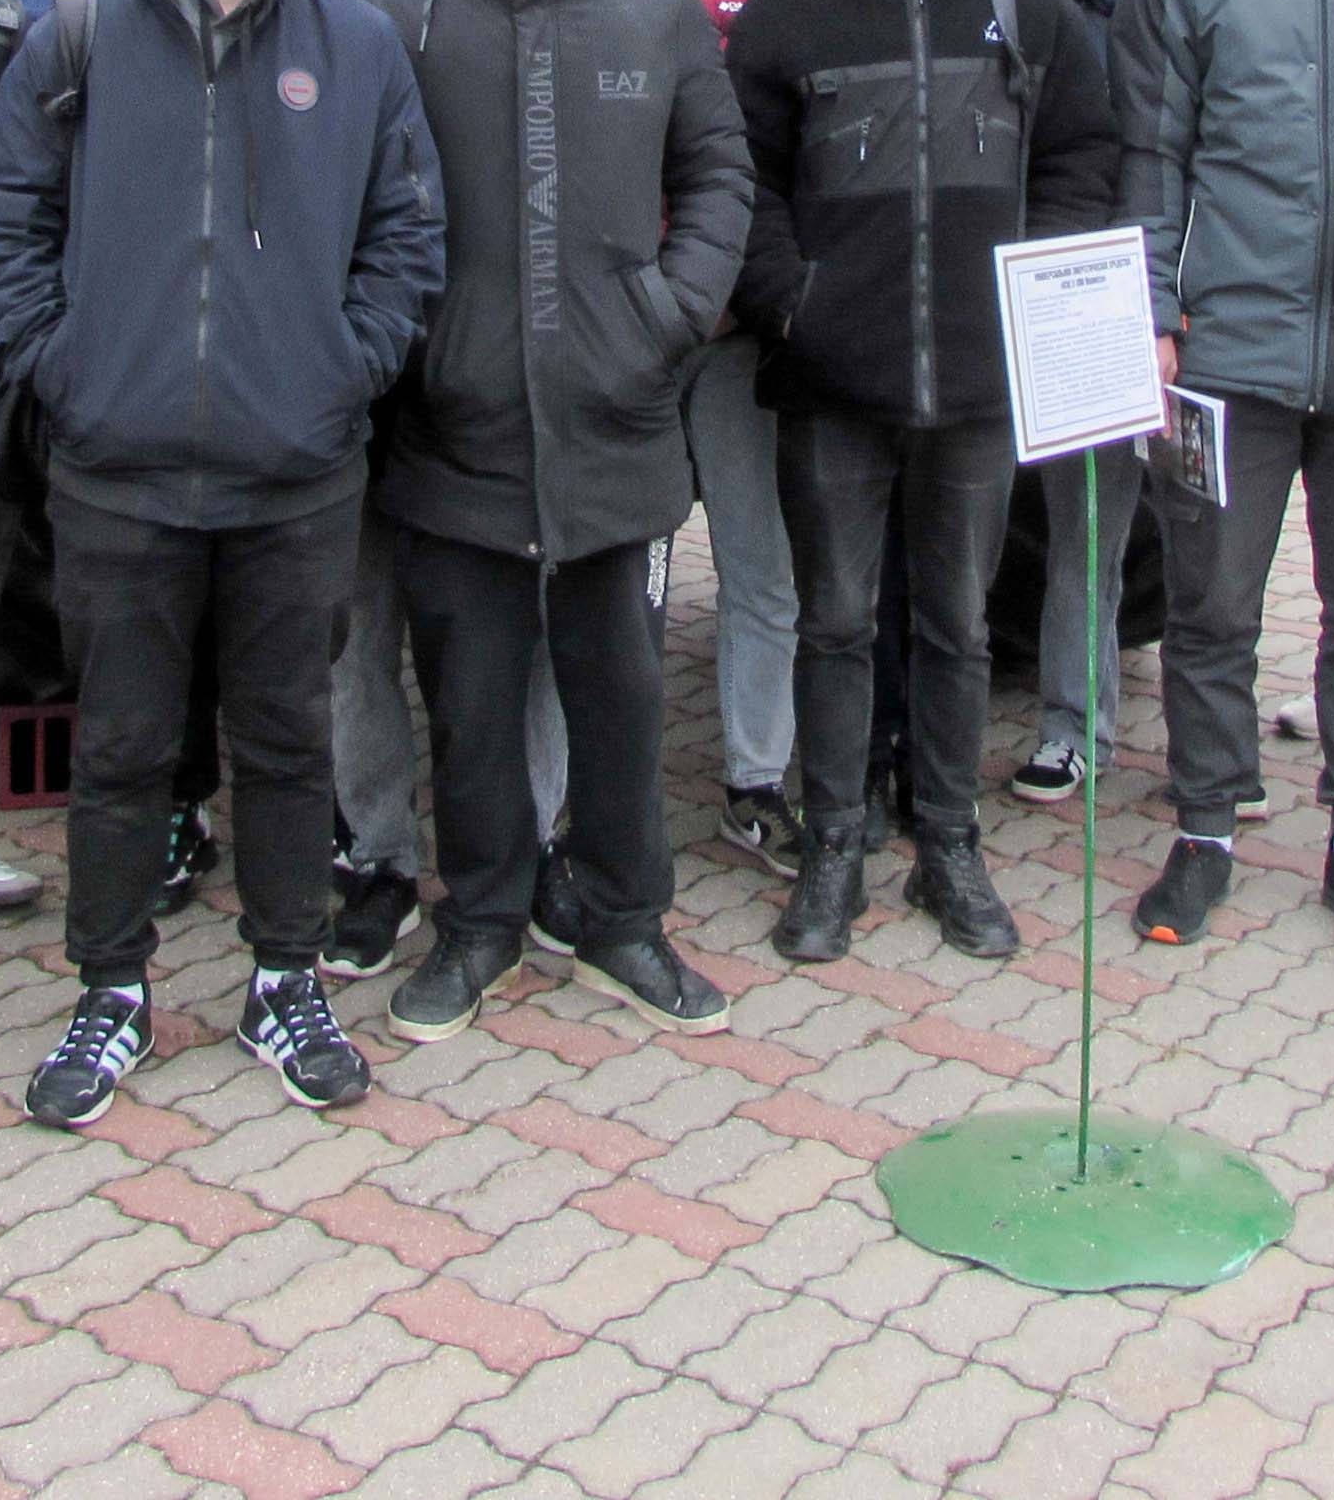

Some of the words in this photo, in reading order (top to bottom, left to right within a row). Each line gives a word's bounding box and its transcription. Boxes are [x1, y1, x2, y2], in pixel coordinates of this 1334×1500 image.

[524, 50, 559, 173] EMPORIO
[598, 71, 648, 93] EA7
[528, 220, 560, 331] ARMANI
